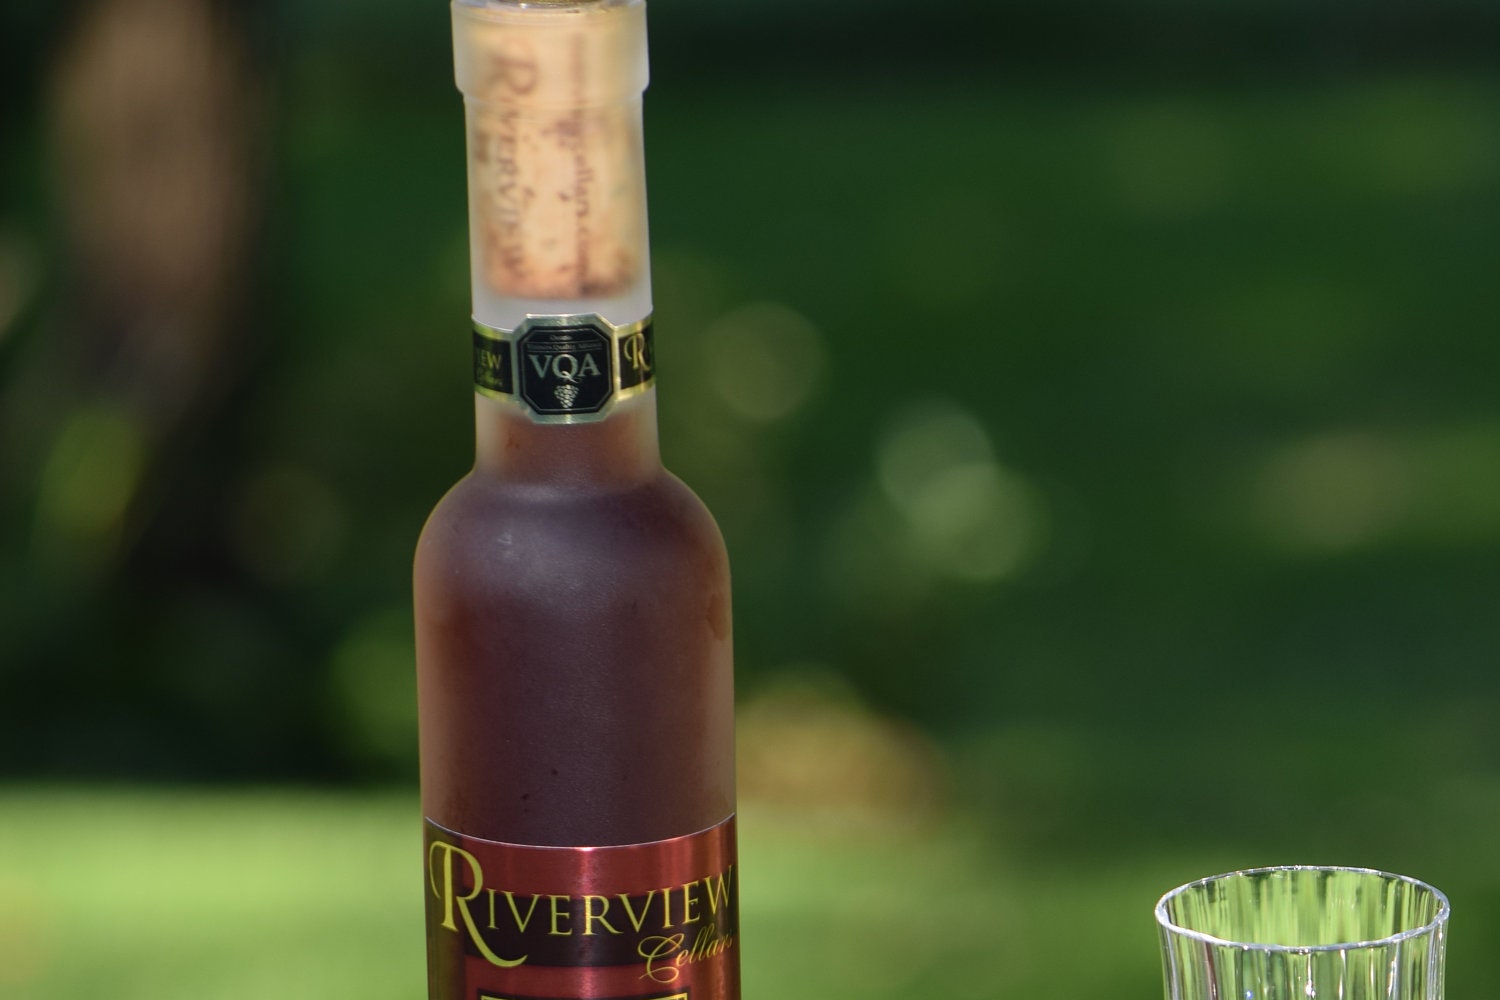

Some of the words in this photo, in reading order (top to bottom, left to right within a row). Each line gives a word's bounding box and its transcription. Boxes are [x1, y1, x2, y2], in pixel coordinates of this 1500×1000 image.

[527, 352, 602, 384] VQA
[429, 840, 733, 968] RIVERVIEW
[637, 922, 733, 984] Cellars
